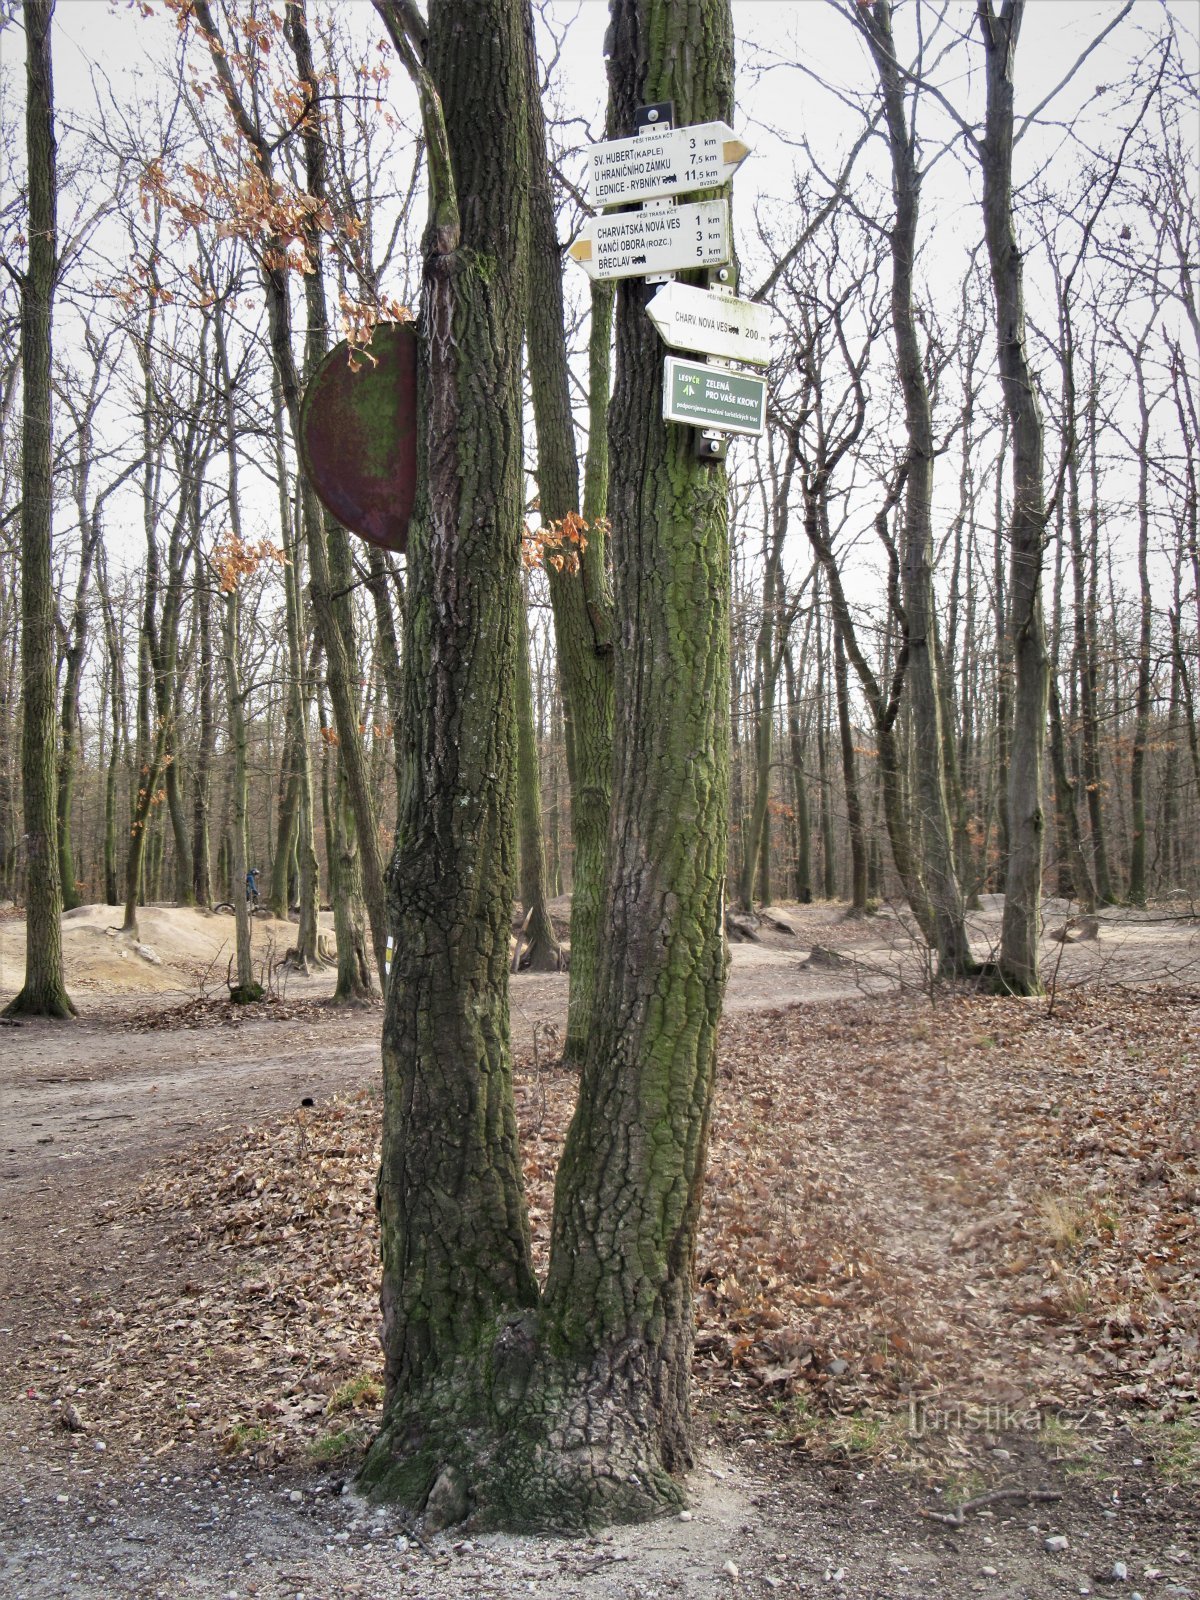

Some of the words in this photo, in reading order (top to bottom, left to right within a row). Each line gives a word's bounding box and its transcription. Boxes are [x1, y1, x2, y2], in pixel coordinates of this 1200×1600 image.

[594, 155, 604, 166] SV.
[690, 138, 696, 149] 3
[594, 171, 599, 181] U
[601, 162, 645, 181] HRANIČNÍHO
[645, 159, 671, 173] ZÁMKU
[705, 154, 717, 162] km
[595, 182, 625, 196] LEDNICE
[631, 174, 661, 190] RYBNÍKY
[705, 170, 718, 178] km
[597, 220, 644, 239] CHARVÁTSKÁ
[645, 218, 665, 232] NOVÁ
[667, 218, 681, 230] VES
[695, 215, 700, 226] 1
[598, 239, 619, 254] KANČÍ
[620, 238, 646, 251] OBORA
[696, 231, 703, 241] 3
[708, 232, 720, 240] km
[598, 256, 630, 269] BŘECLAV
[696, 246, 703, 256] 5
[717, 321, 729, 333] VES
[745, 328, 759, 340] 200
[706, 379, 730, 391] ZELENÁ
[676, 402, 707, 413] podporujeme
[706, 407, 724, 416] značení
[705, 390, 718, 400] PRO
[719, 392, 736, 404] VAŠE
[736, 397, 759, 408] KROKY
